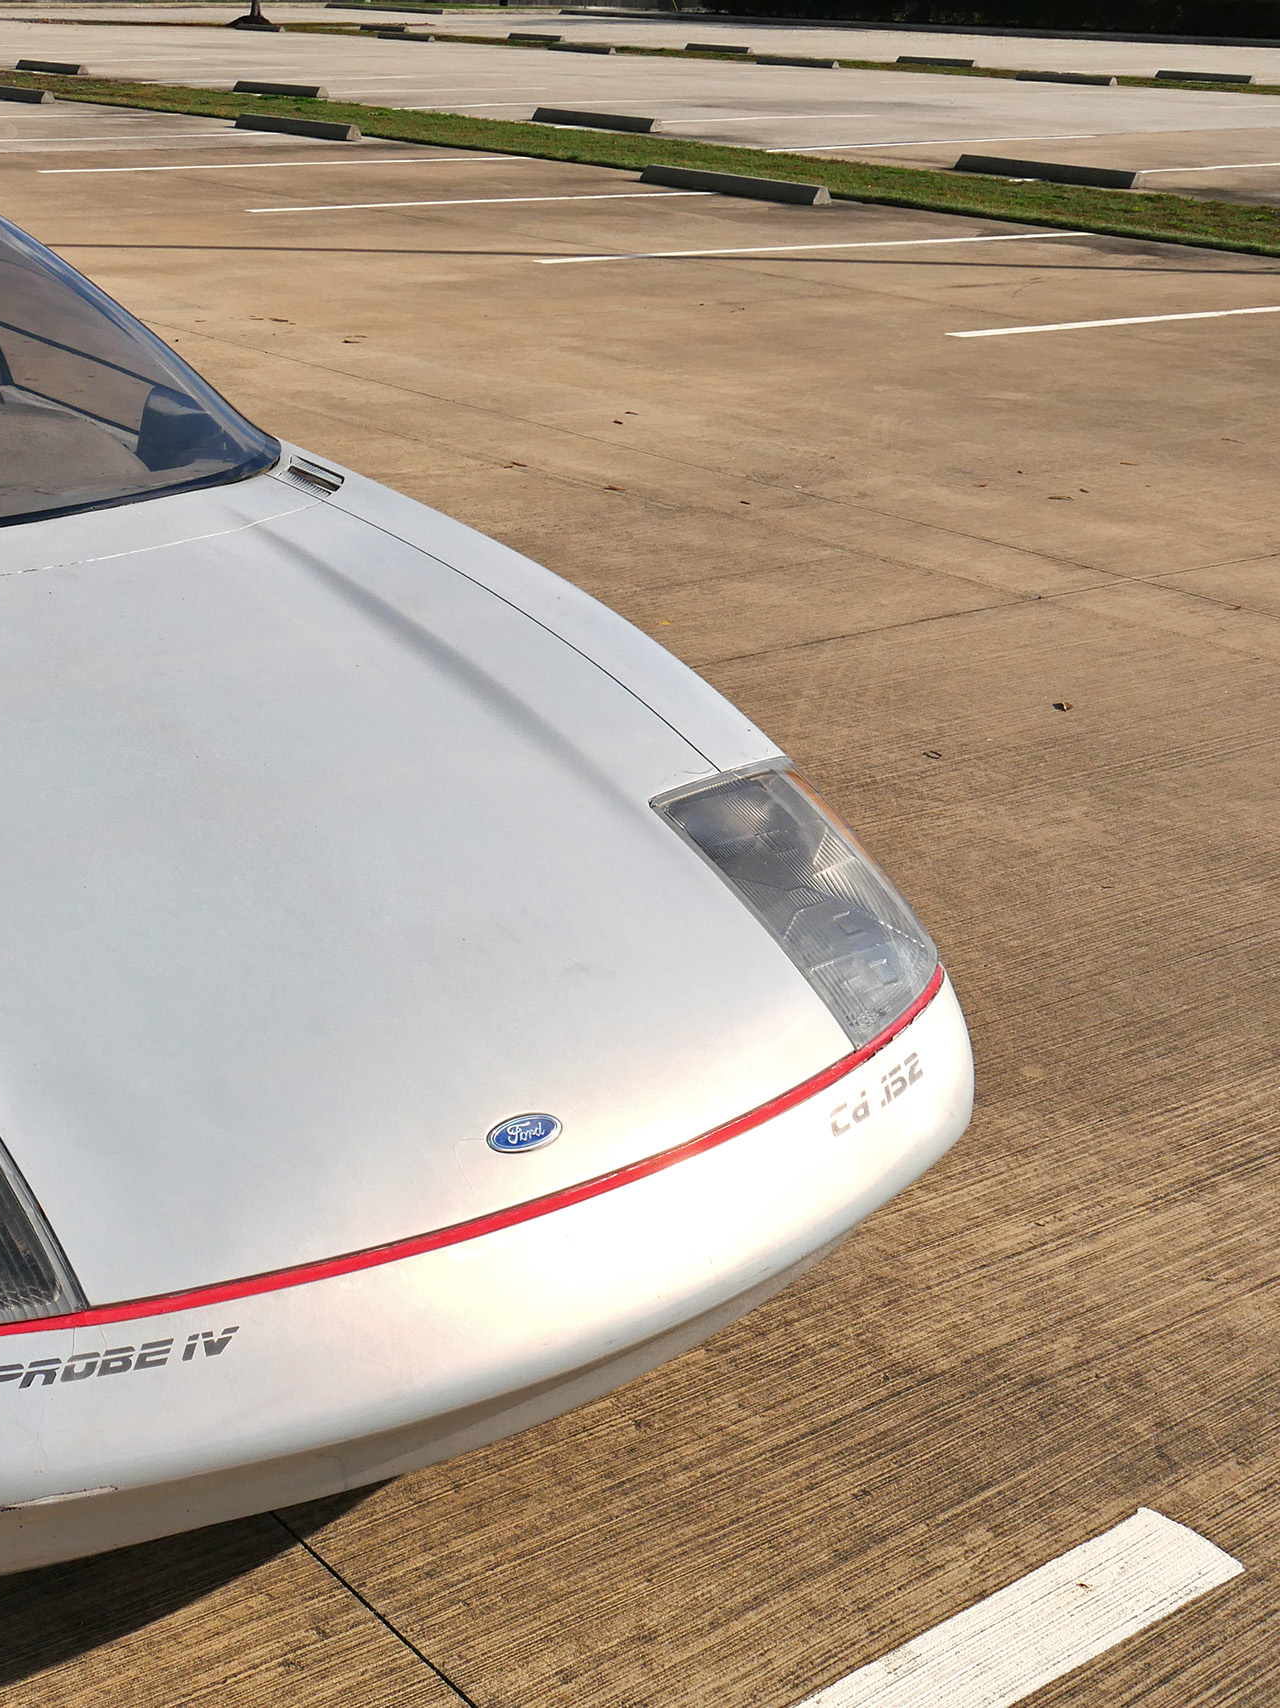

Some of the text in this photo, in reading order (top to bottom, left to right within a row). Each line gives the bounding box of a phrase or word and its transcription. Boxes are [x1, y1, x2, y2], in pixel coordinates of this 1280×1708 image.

[830, 1052, 924, 1138] Cd .152
[506, 1121, 545, 1145] Ford
[182, 1325, 240, 1362] IV
